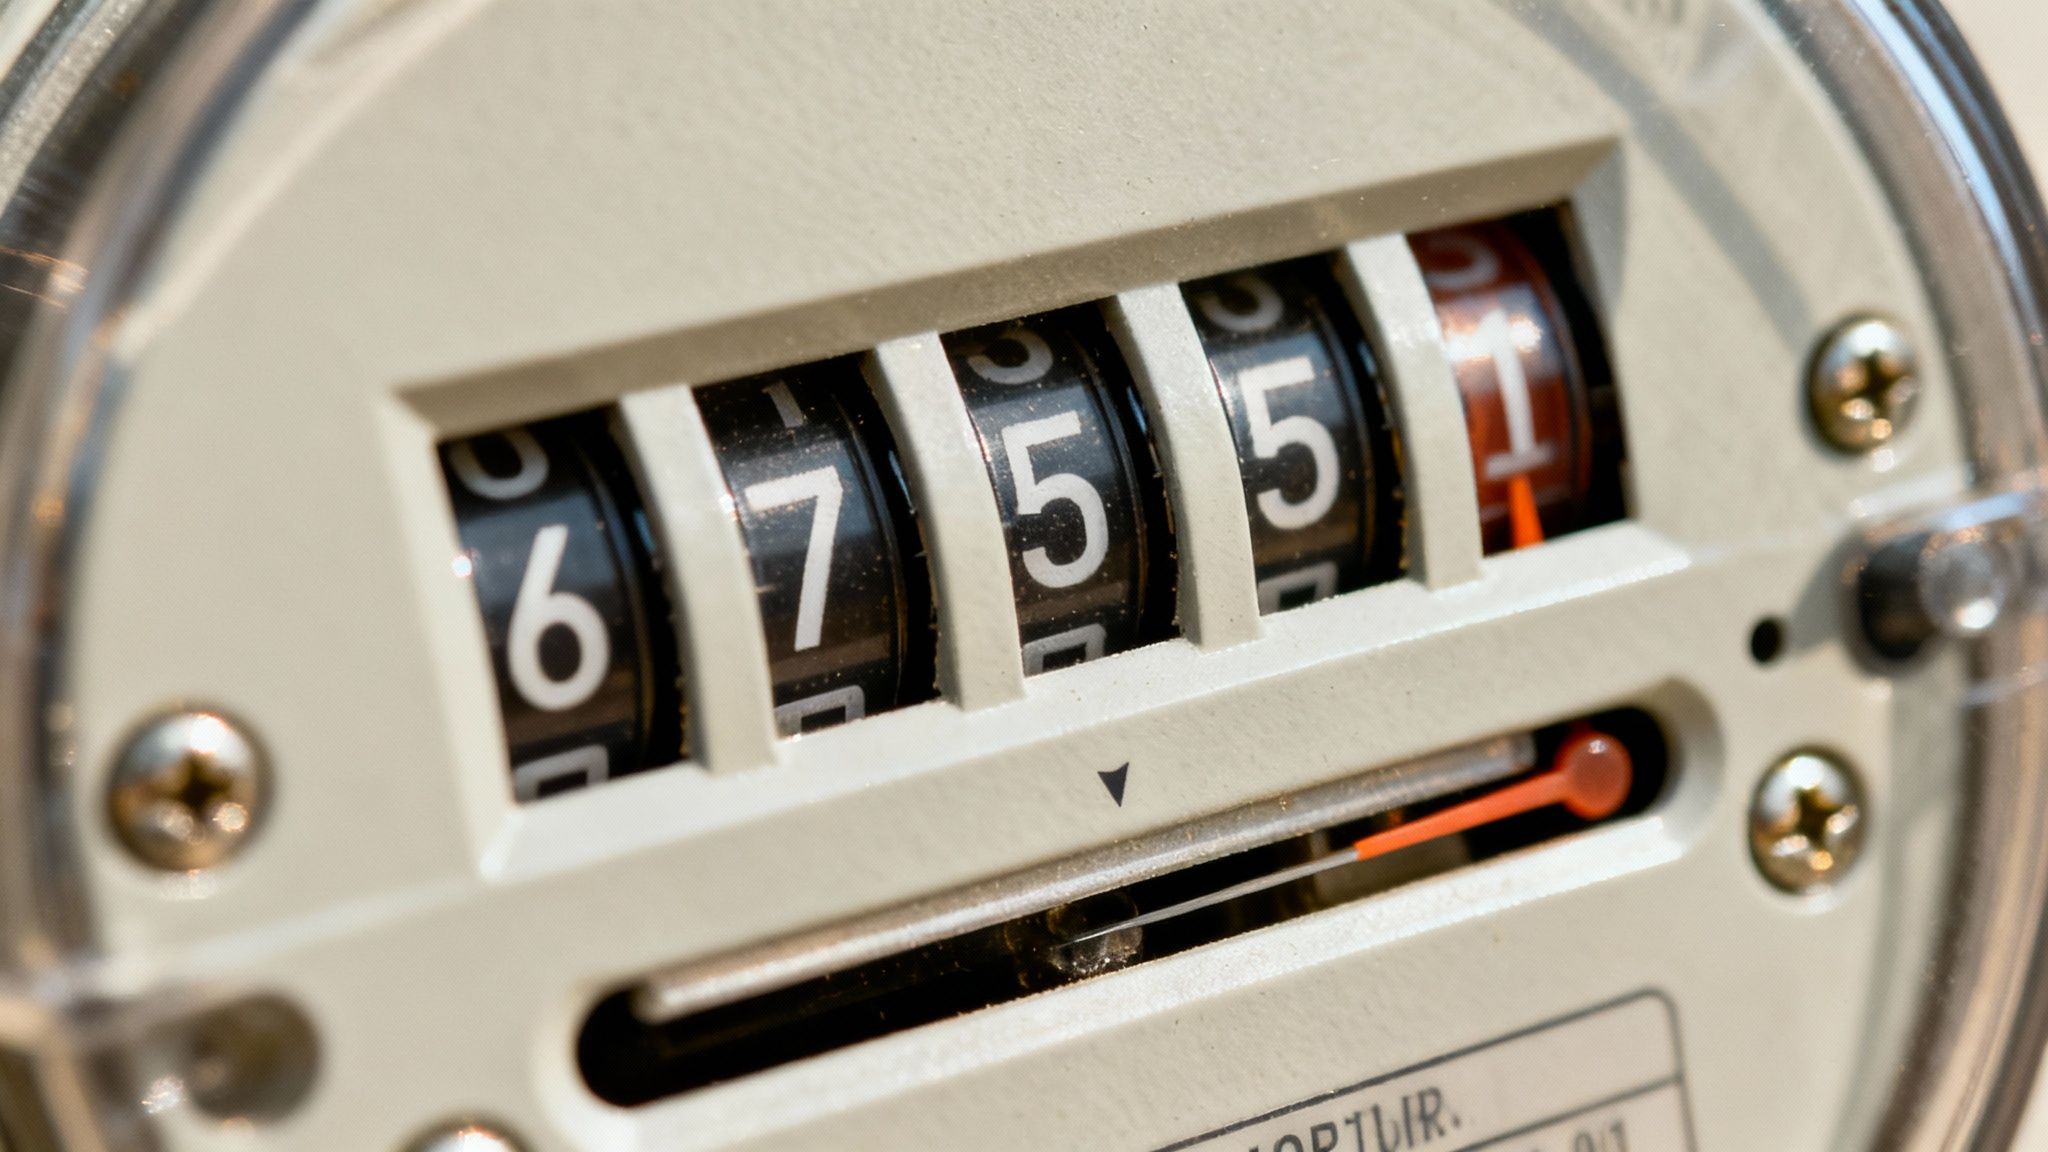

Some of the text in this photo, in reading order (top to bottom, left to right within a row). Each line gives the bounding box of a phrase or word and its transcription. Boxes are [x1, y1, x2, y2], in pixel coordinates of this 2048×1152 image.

[506, 524, 610, 712] 6
[744, 465, 843, 651] 7
[1001, 411, 1109, 588] 5
[1236, 356, 1340, 530] 5
